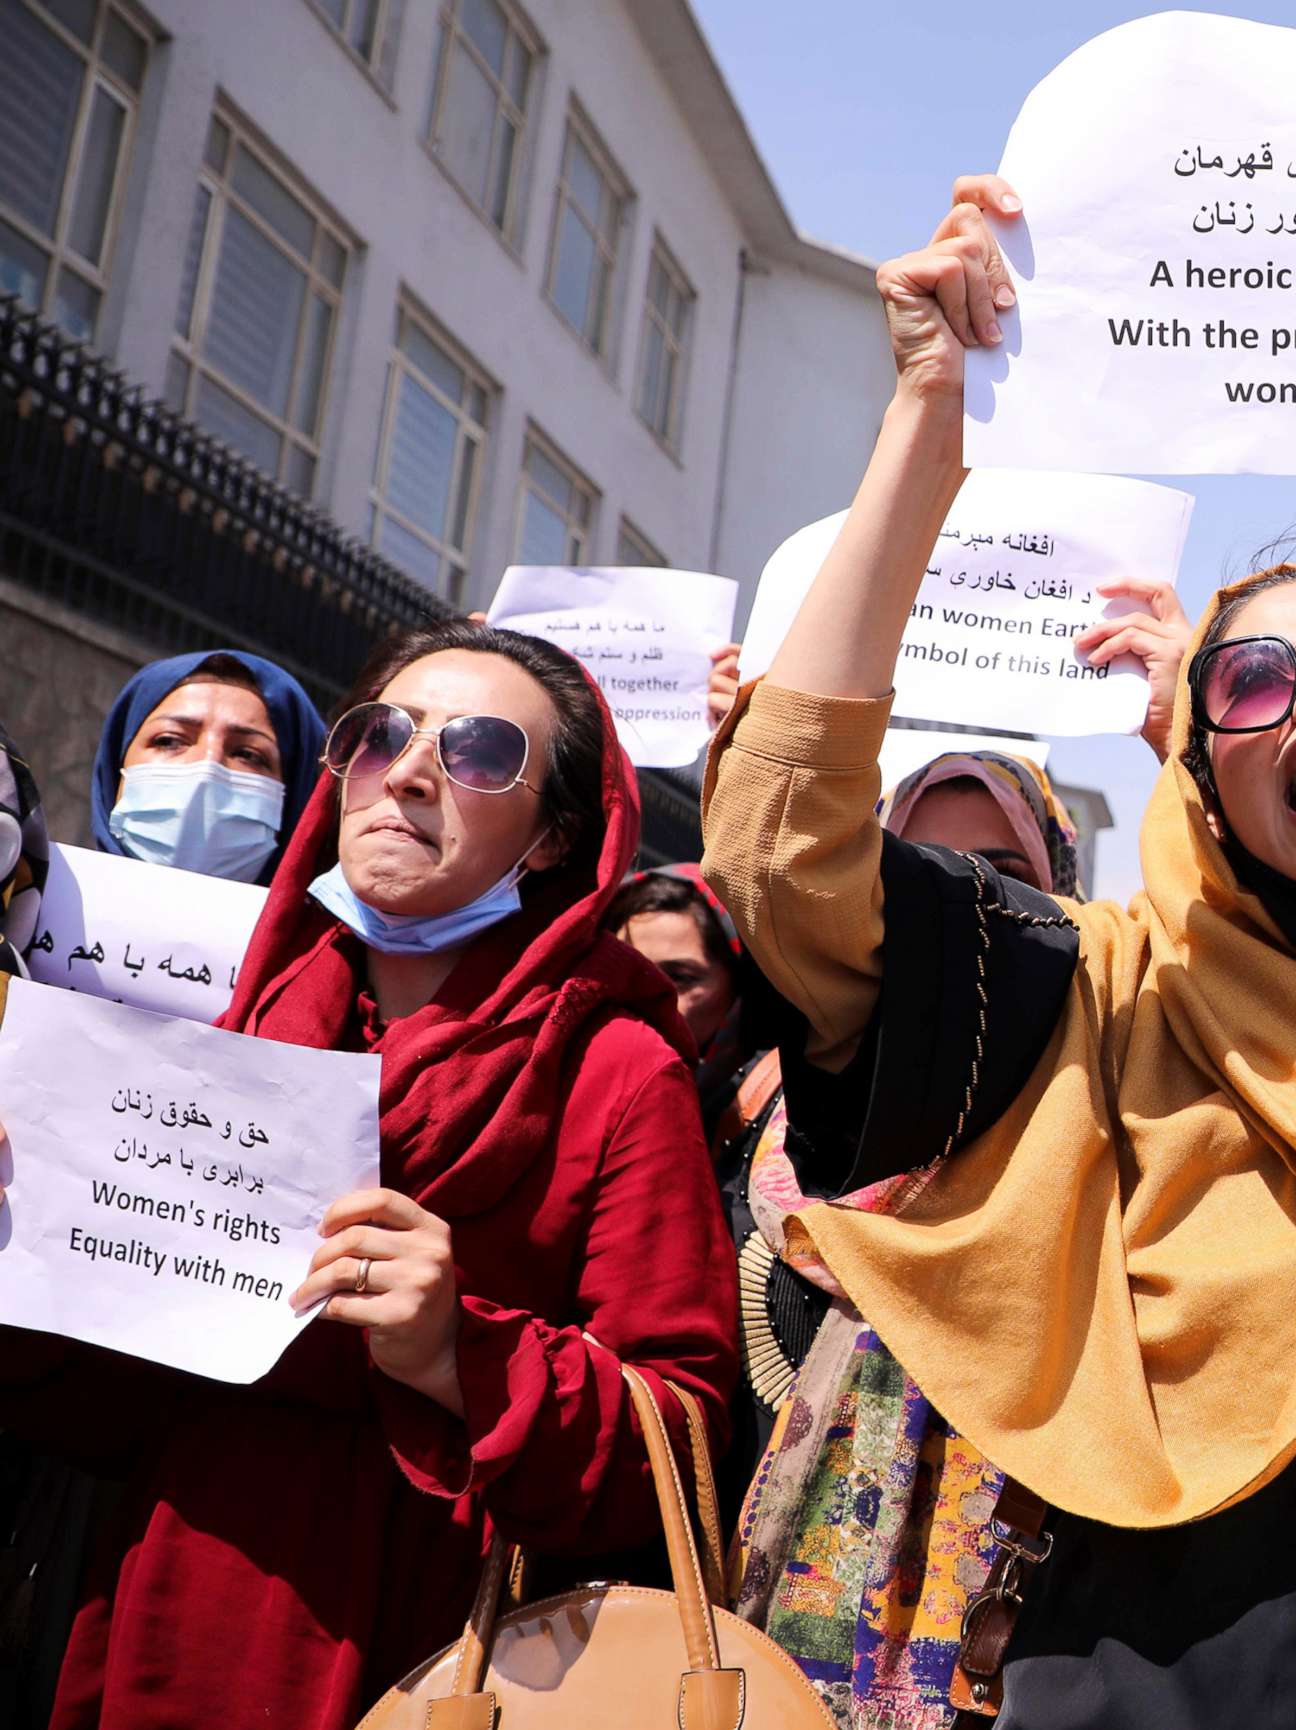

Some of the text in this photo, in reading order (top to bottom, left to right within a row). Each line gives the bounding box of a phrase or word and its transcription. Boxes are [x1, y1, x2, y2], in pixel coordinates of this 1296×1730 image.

[1174, 141, 1273, 178] قهرمان
[1192, 201, 1254, 233] زنان
[1149, 260, 1174, 288] A
[1186, 259, 1292, 290] heroic
[1108, 318, 1191, 347] With
[1202, 320, 1259, 349] the
[1002, 533, 1054, 557] افغانه
[1024, 579, 1073, 600] افغان
[943, 608, 1032, 635] women
[1041, 618, 1096, 637] Eart
[900, 642, 1110, 679] mbol of this land
[611, 676, 679, 693] together
[614, 705, 701, 721] oppression
[67, 940, 105, 971] هم
[123, 942, 145, 979] با
[157, 954, 212, 985] همه
[111, 1088, 269, 1148] حق و حقوق زنان
[114, 1137, 264, 1194] برابری با مردان
[91, 1180, 282, 1245] Women's rights
[69, 1226, 284, 1301] Equality with men
